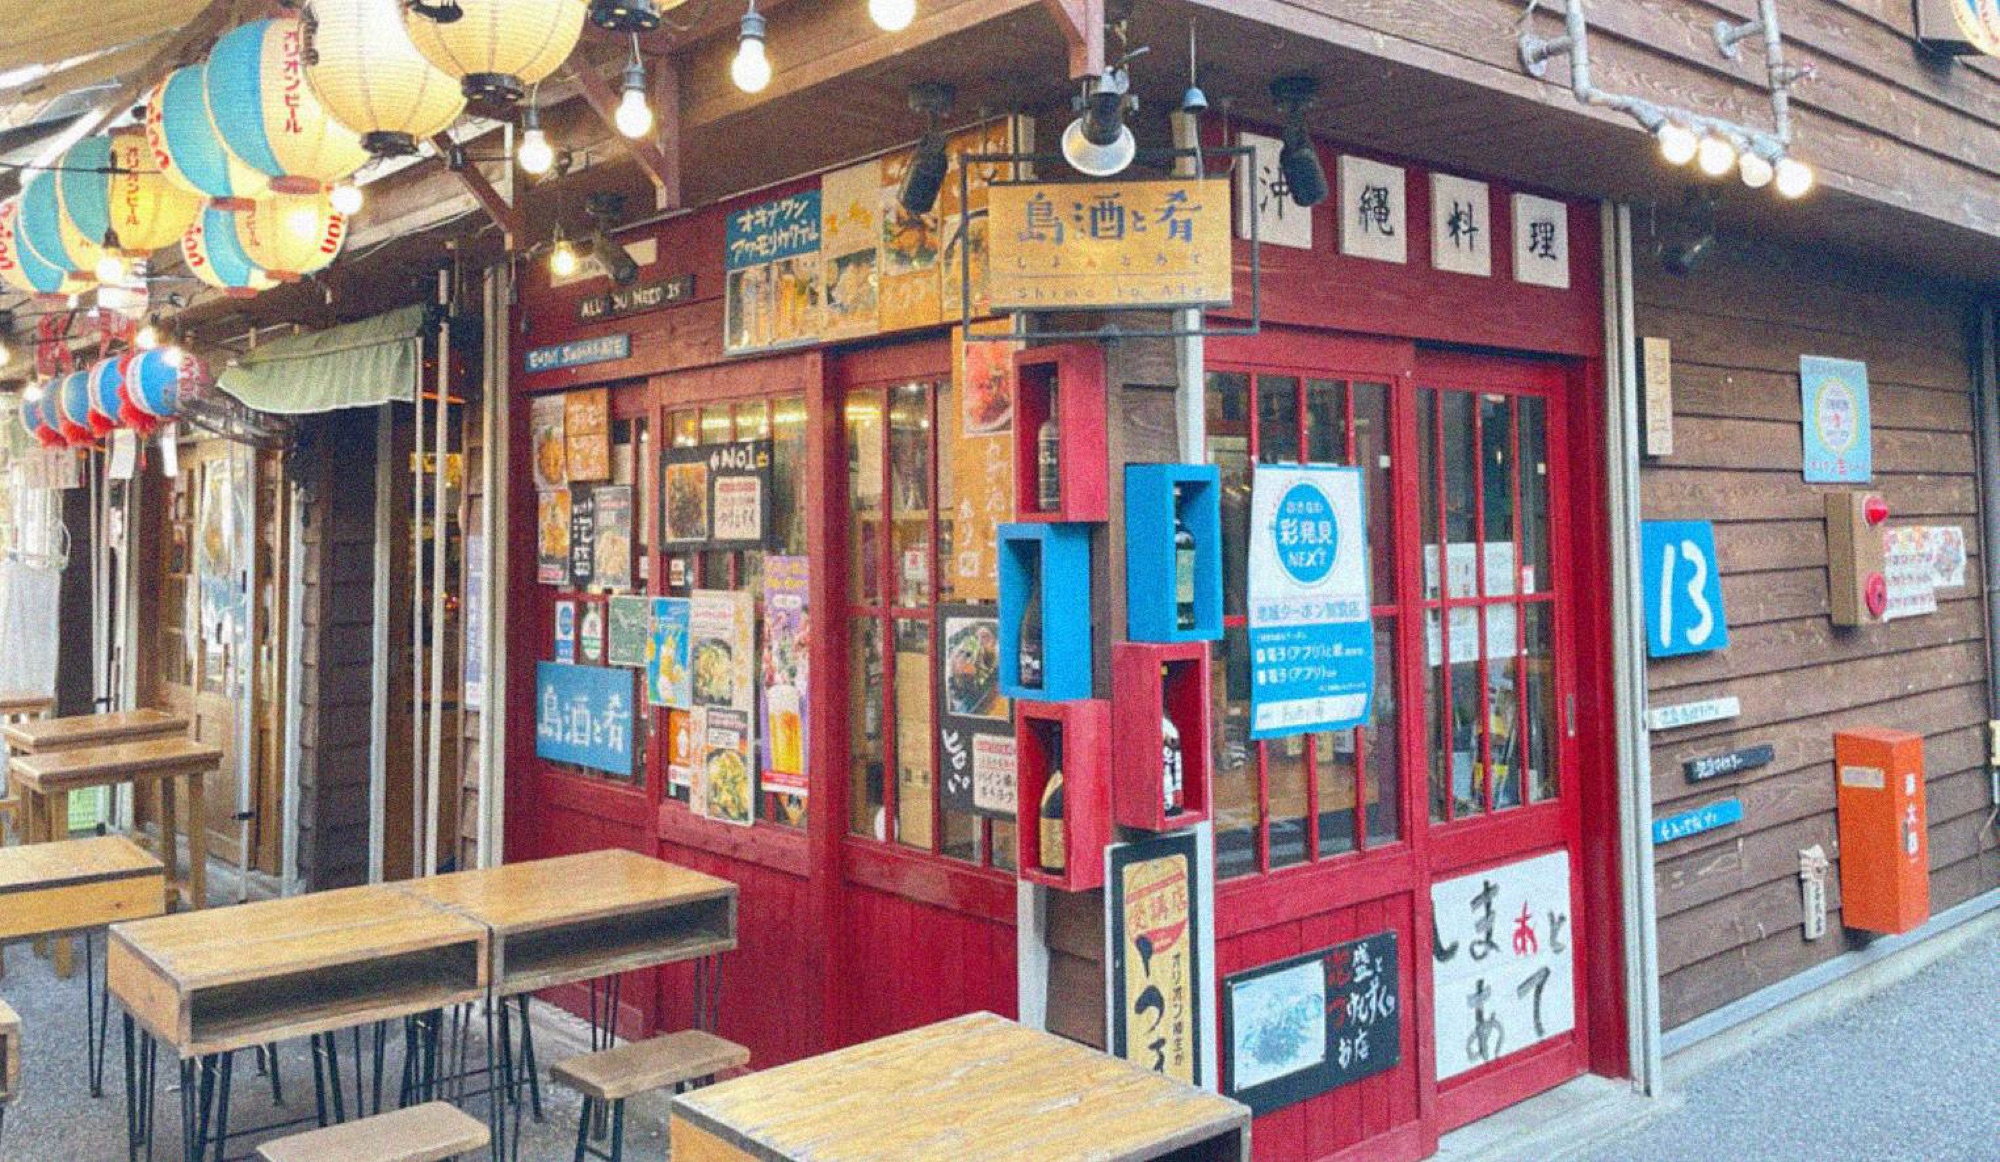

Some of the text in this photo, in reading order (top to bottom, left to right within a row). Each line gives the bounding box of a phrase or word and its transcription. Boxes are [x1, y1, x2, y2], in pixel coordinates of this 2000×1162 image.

[1016, 189, 1204, 246] 島酒と肴
[1280, 518, 1333, 545] 彩発見
[1288, 547, 1328, 567] NEXT
[1658, 538, 1714, 648] 13
